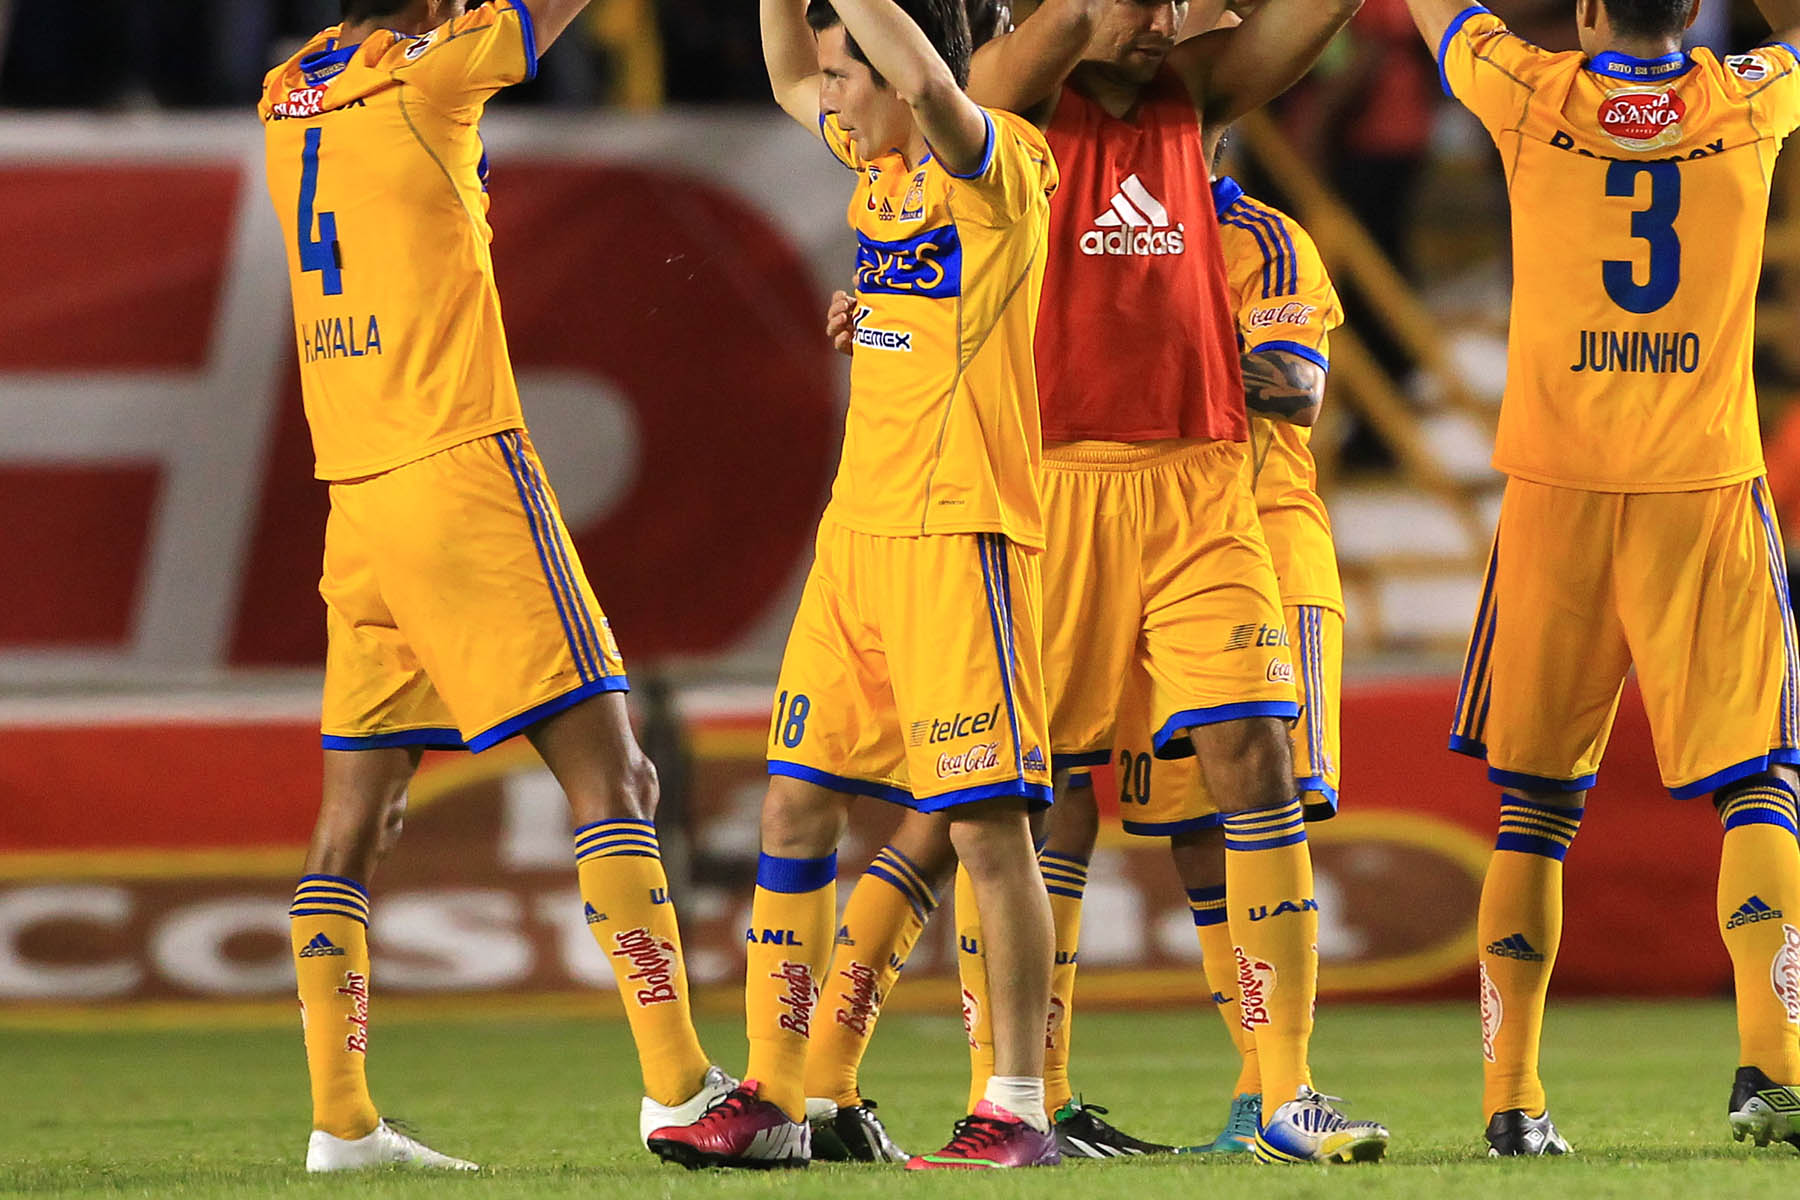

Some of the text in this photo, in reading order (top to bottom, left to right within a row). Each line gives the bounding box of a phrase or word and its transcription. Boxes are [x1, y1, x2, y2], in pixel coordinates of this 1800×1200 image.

[297, 127, 343, 296] 4
[1079, 223, 1183, 256] adidas
[1601, 160, 1682, 315] 3
[1570, 330, 1700, 374] JUNINHO
[774, 691, 811, 749] 18
[928, 703, 1001, 744] telcel
[936, 743, 1000, 779] Coca-Cola
[1120, 749, 1152, 805] 20
[1248, 898, 1319, 922] UAN
[1726, 909, 1784, 930] adidas
[746, 928, 803, 947] ANL
[1486, 945, 1545, 962] adidas
[612, 927, 677, 1007] Bokados
[770, 960, 815, 1039] Bokados
